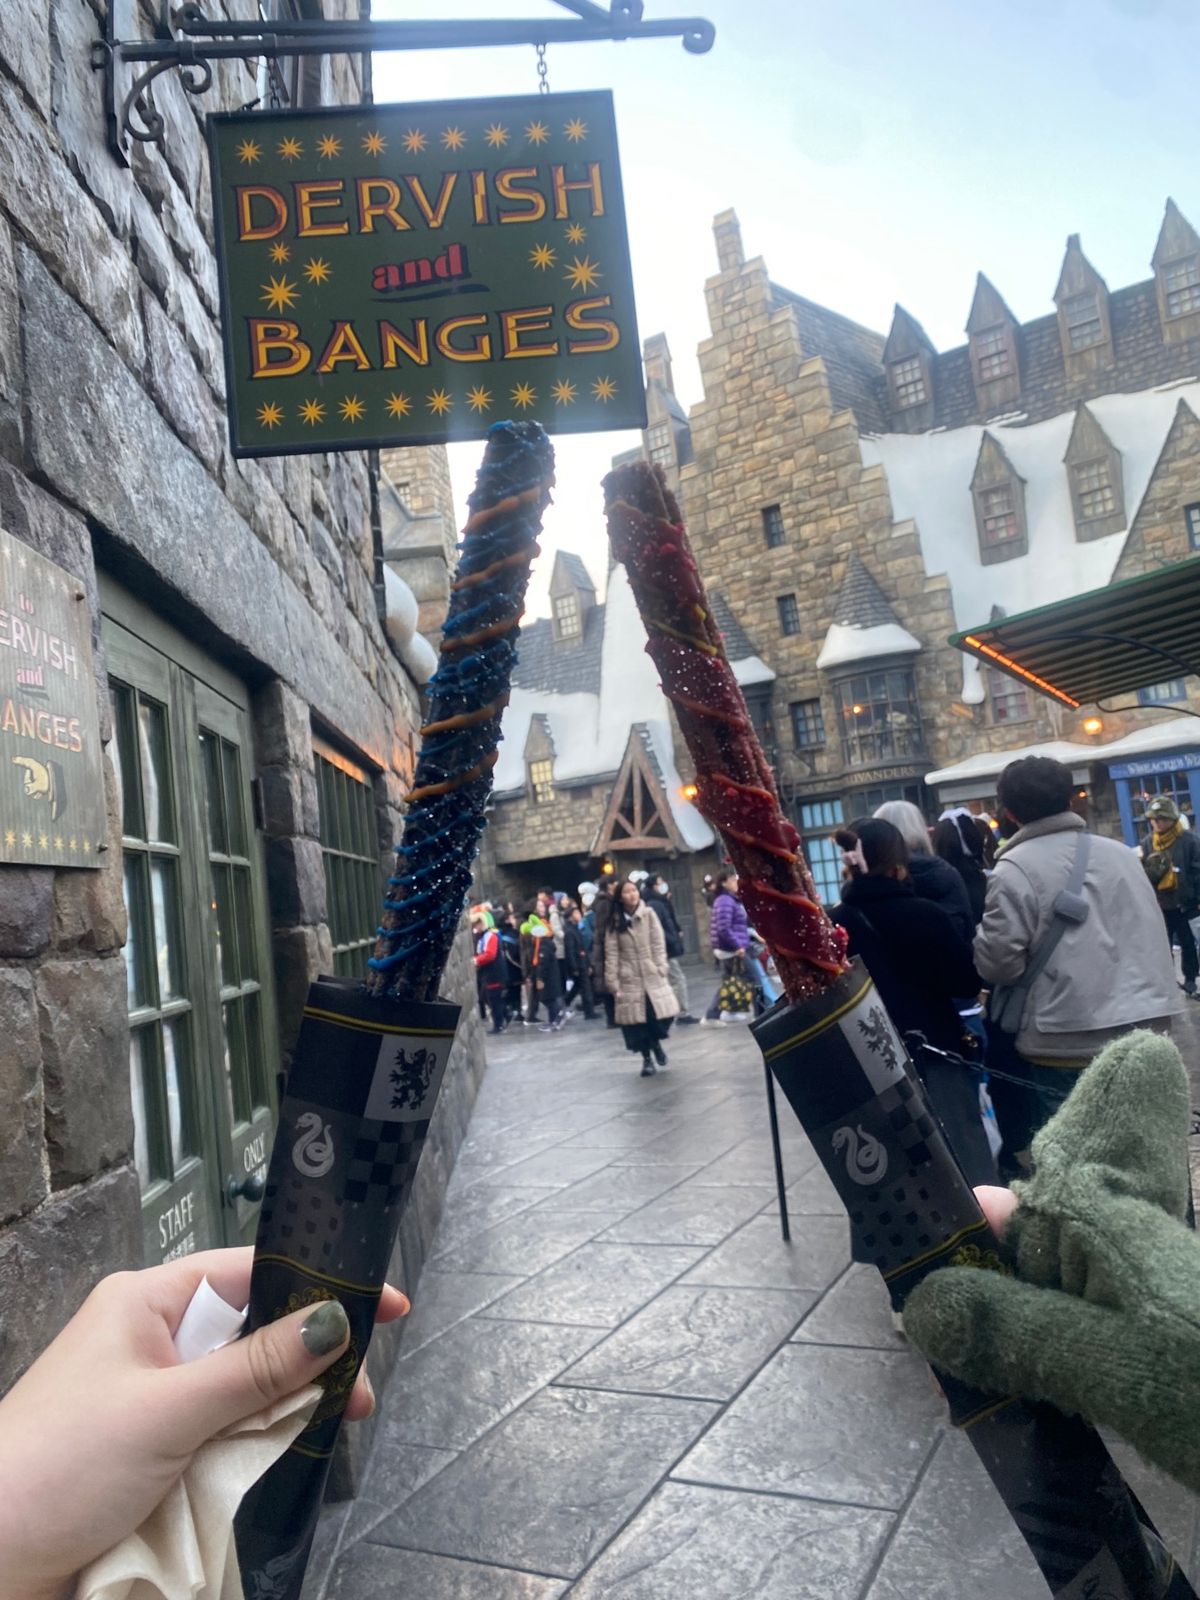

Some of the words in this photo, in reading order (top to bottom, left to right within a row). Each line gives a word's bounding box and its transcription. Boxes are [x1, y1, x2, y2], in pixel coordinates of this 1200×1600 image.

[235, 162, 605, 242] DERVISH
[371, 243, 471, 293] and
[245, 296, 621, 380] BANGES
[0, 608, 79, 681] ERVISH
[16, 665, 44, 687] and
[0, 697, 82, 753] ANGES
[243, 1132, 266, 1173] ONLY
[158, 1191, 194, 1249] STAFF
